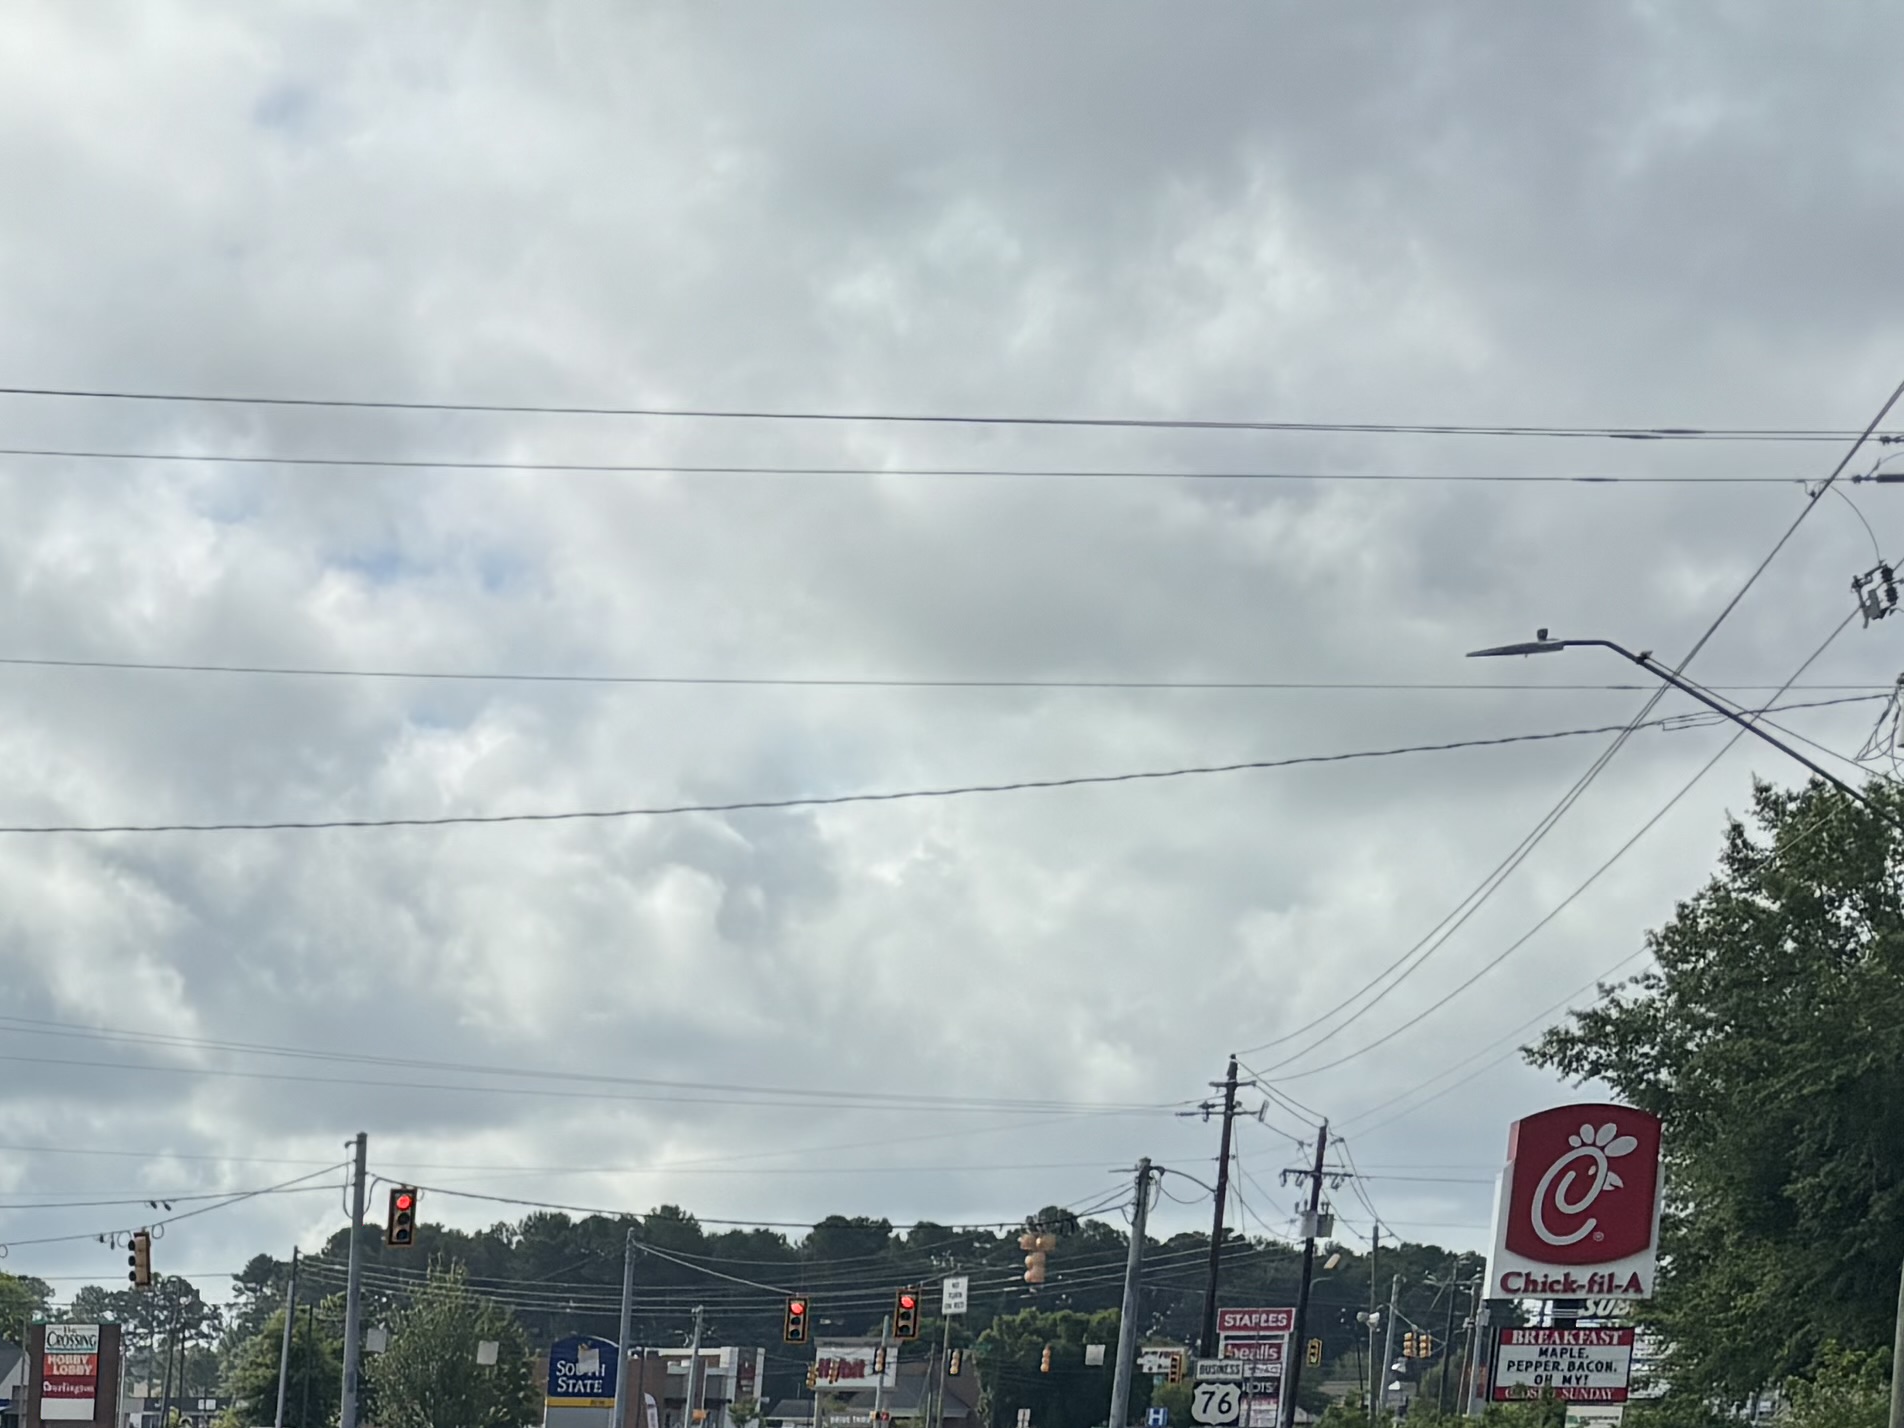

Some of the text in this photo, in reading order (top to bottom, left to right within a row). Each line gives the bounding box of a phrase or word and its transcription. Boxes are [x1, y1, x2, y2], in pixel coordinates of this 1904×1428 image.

[1499, 1271, 1645, 1295] Chick-fil-A
[1224, 1314, 1287, 1327] STAPLES
[1511, 1330, 1622, 1345] BREAKFAST
[48, 1355, 88, 1365] HOBBY
[52, 1365, 92, 1375] LOBBY
[1200, 1365, 1240, 1375] BUSINESS
[557, 1378, 603, 1393] STATE
[1562, 1388, 1613, 1400] SUNDAY
[1202, 1391, 1232, 1414] 76
[1149, 1409, 1163, 1426] H
